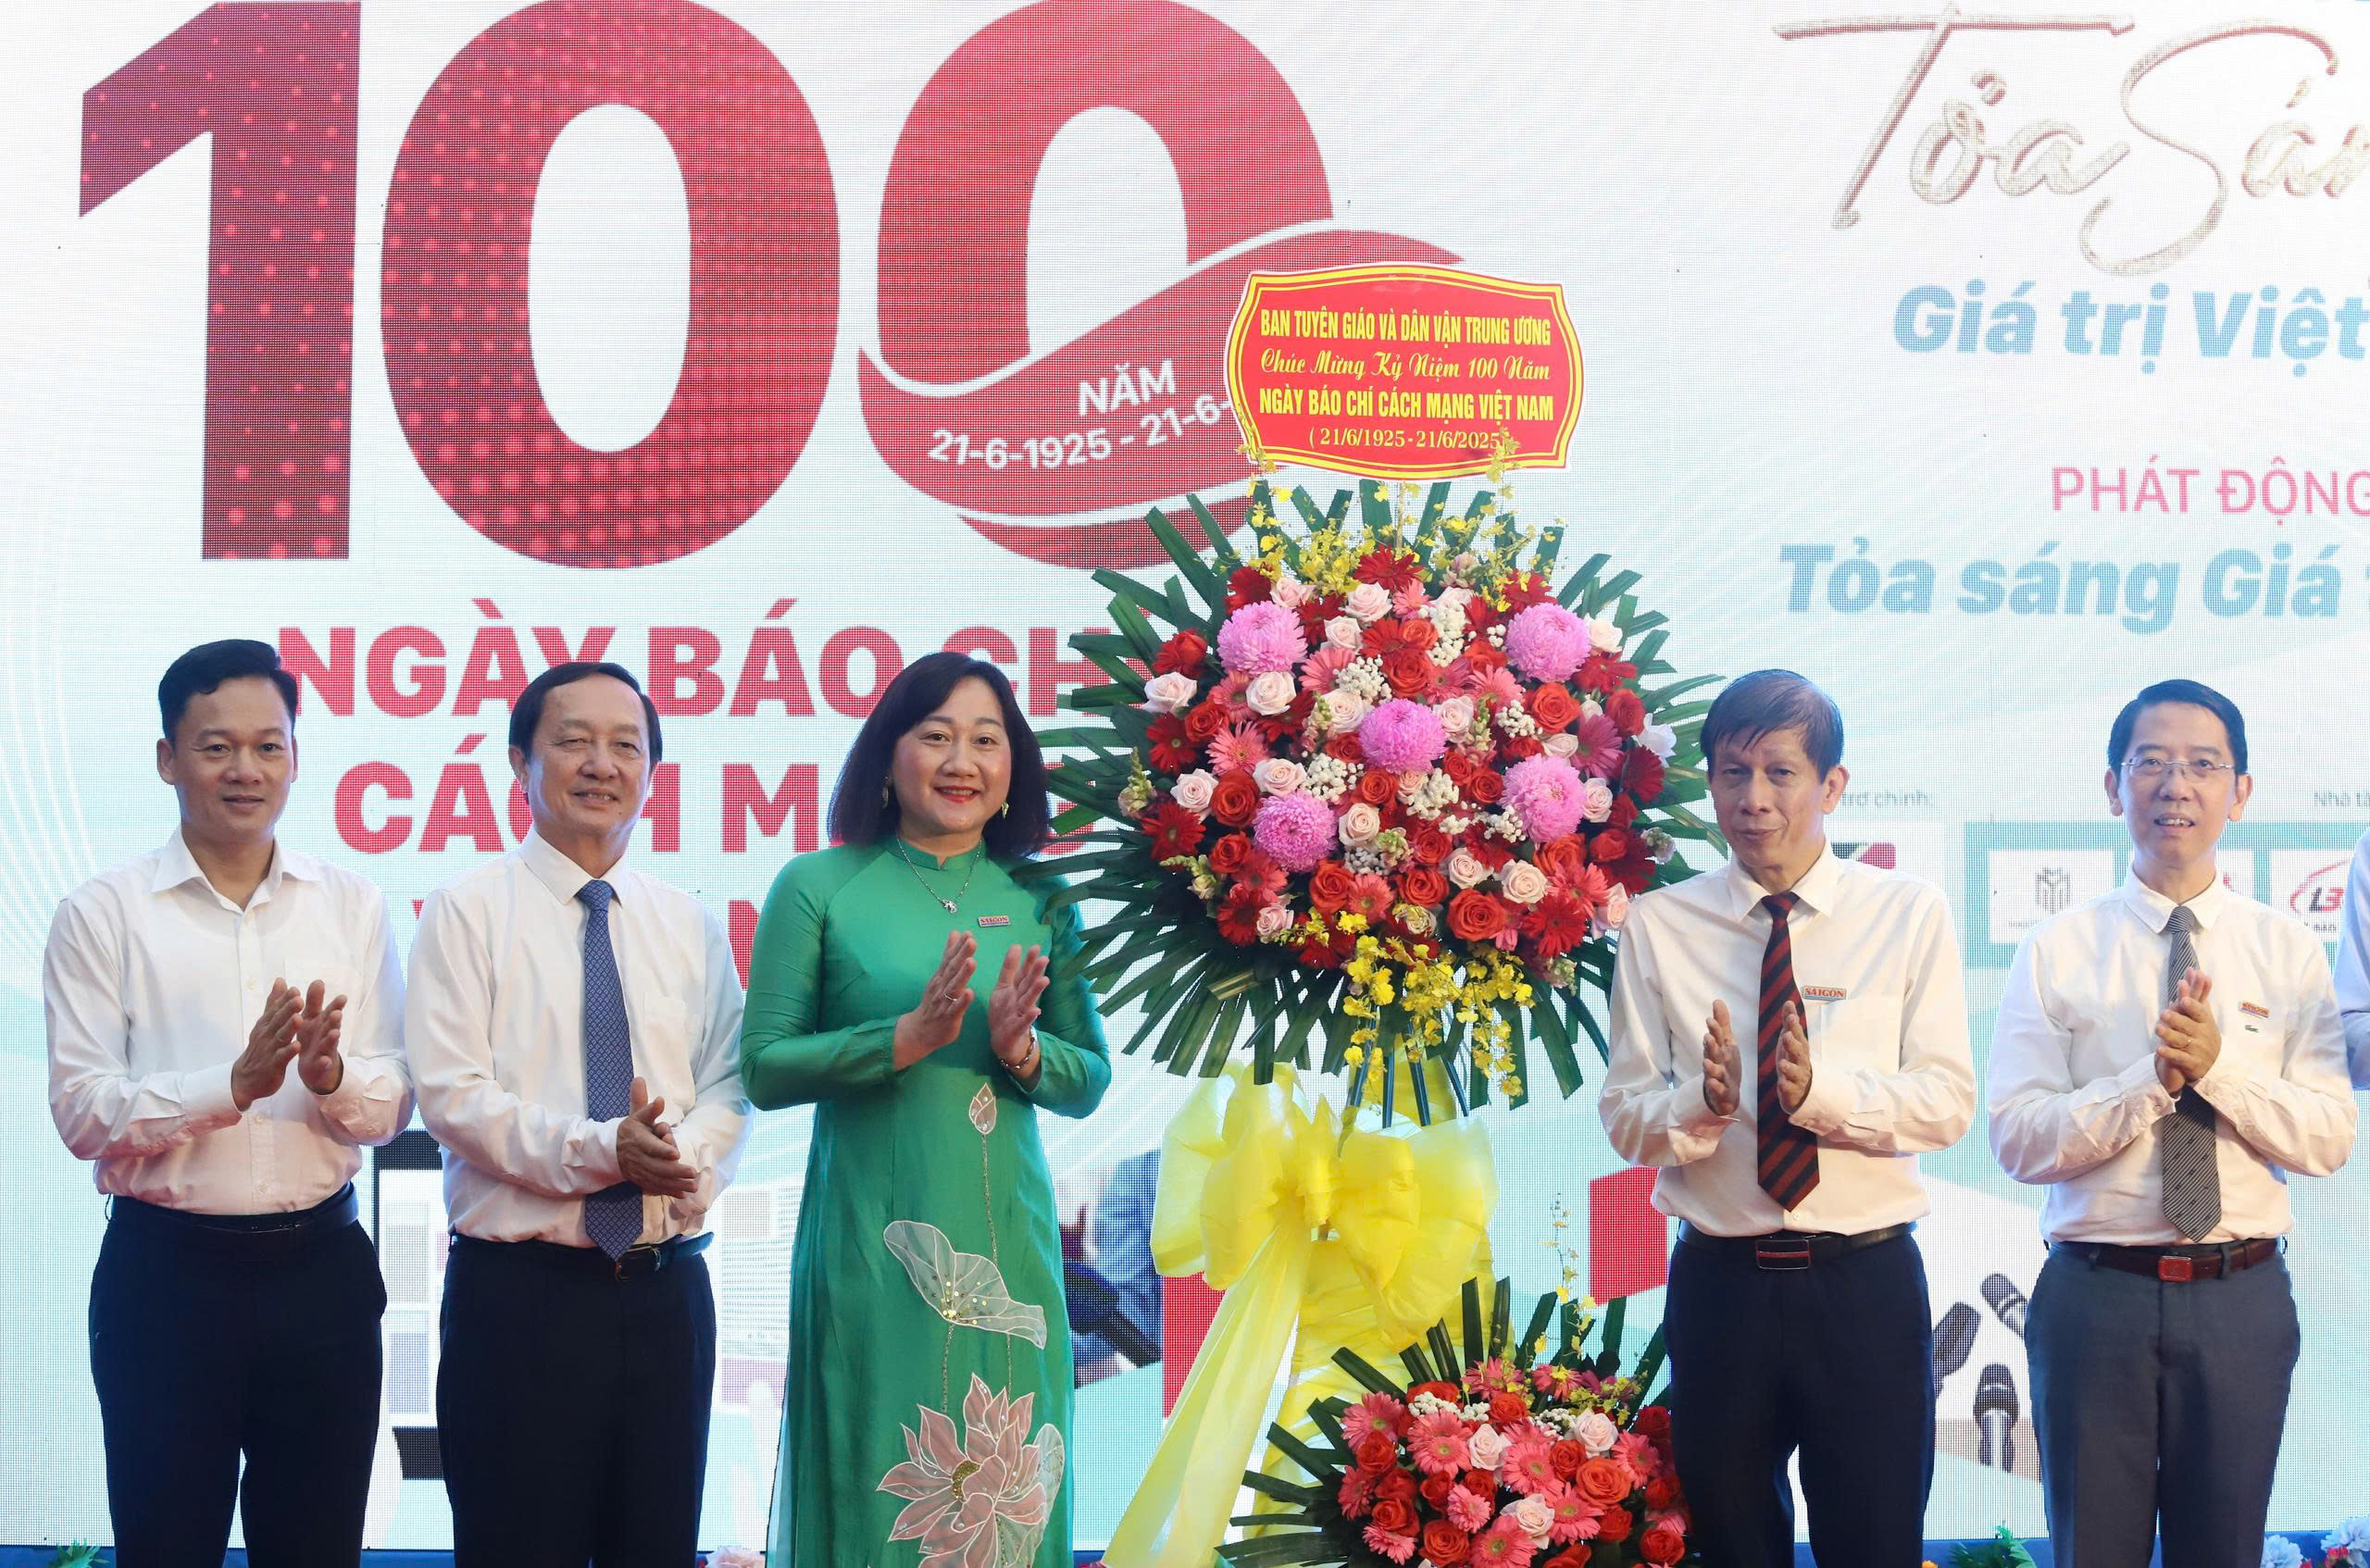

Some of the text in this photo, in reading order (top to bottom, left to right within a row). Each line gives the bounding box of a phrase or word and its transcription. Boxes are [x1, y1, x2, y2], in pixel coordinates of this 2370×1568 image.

[1773, 2, 2135, 230] Tỏa
[1260, 305, 1551, 348] BAN TUYÊN GIÁO VÀ DÂN VẬN TRUNG ƯƠNG
[1892, 280, 2370, 377] Giá trị Việt
[1079, 359, 1178, 417] NĂM
[1260, 348, 1551, 383] Chúc Mừng Kỷ Niệm 100 Năm
[929, 428, 1112, 469] 21-6-1925
[1140, 393, 1232, 447] 21-6-
[1259, 384, 1554, 425] NGÀY BÁO CHÍ CÁCH MẠNG VIỆT NAM
[1319, 428, 1405, 447] 21/6/1925
[2052, 455, 2370, 527] PHÁT ĐỘNG
[1779, 536, 2342, 635] Tỏa sáng Giá
[648, 598, 904, 717] BÁO
[1804, 988, 1845, 998] SAIGON
